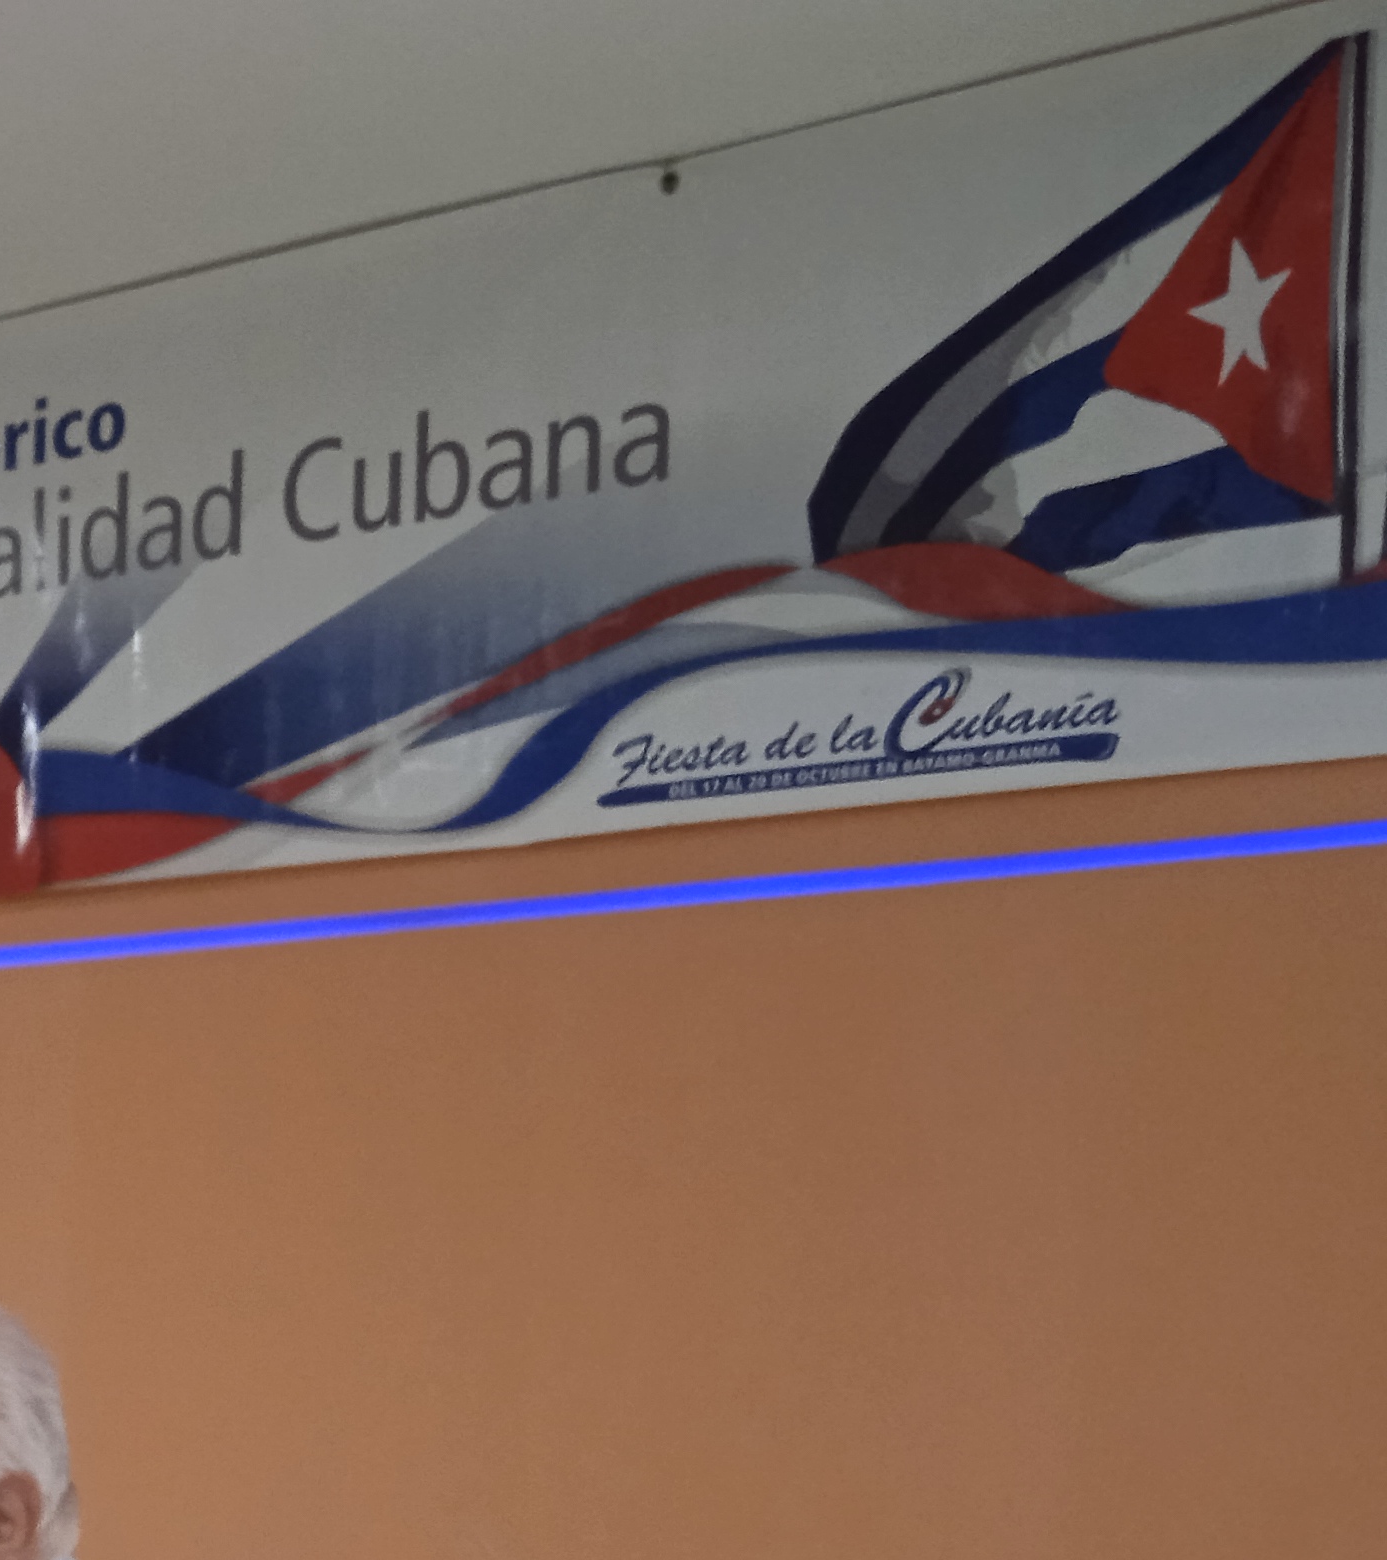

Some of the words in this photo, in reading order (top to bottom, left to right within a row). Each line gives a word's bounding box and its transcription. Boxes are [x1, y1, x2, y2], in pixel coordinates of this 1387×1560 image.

[284, 402, 670, 541] Cubana
[612, 733, 750, 787] Fiesta
[764, 721, 817, 760] de
[830, 713, 878, 754] la
[883, 666, 1121, 756] Cubanía
